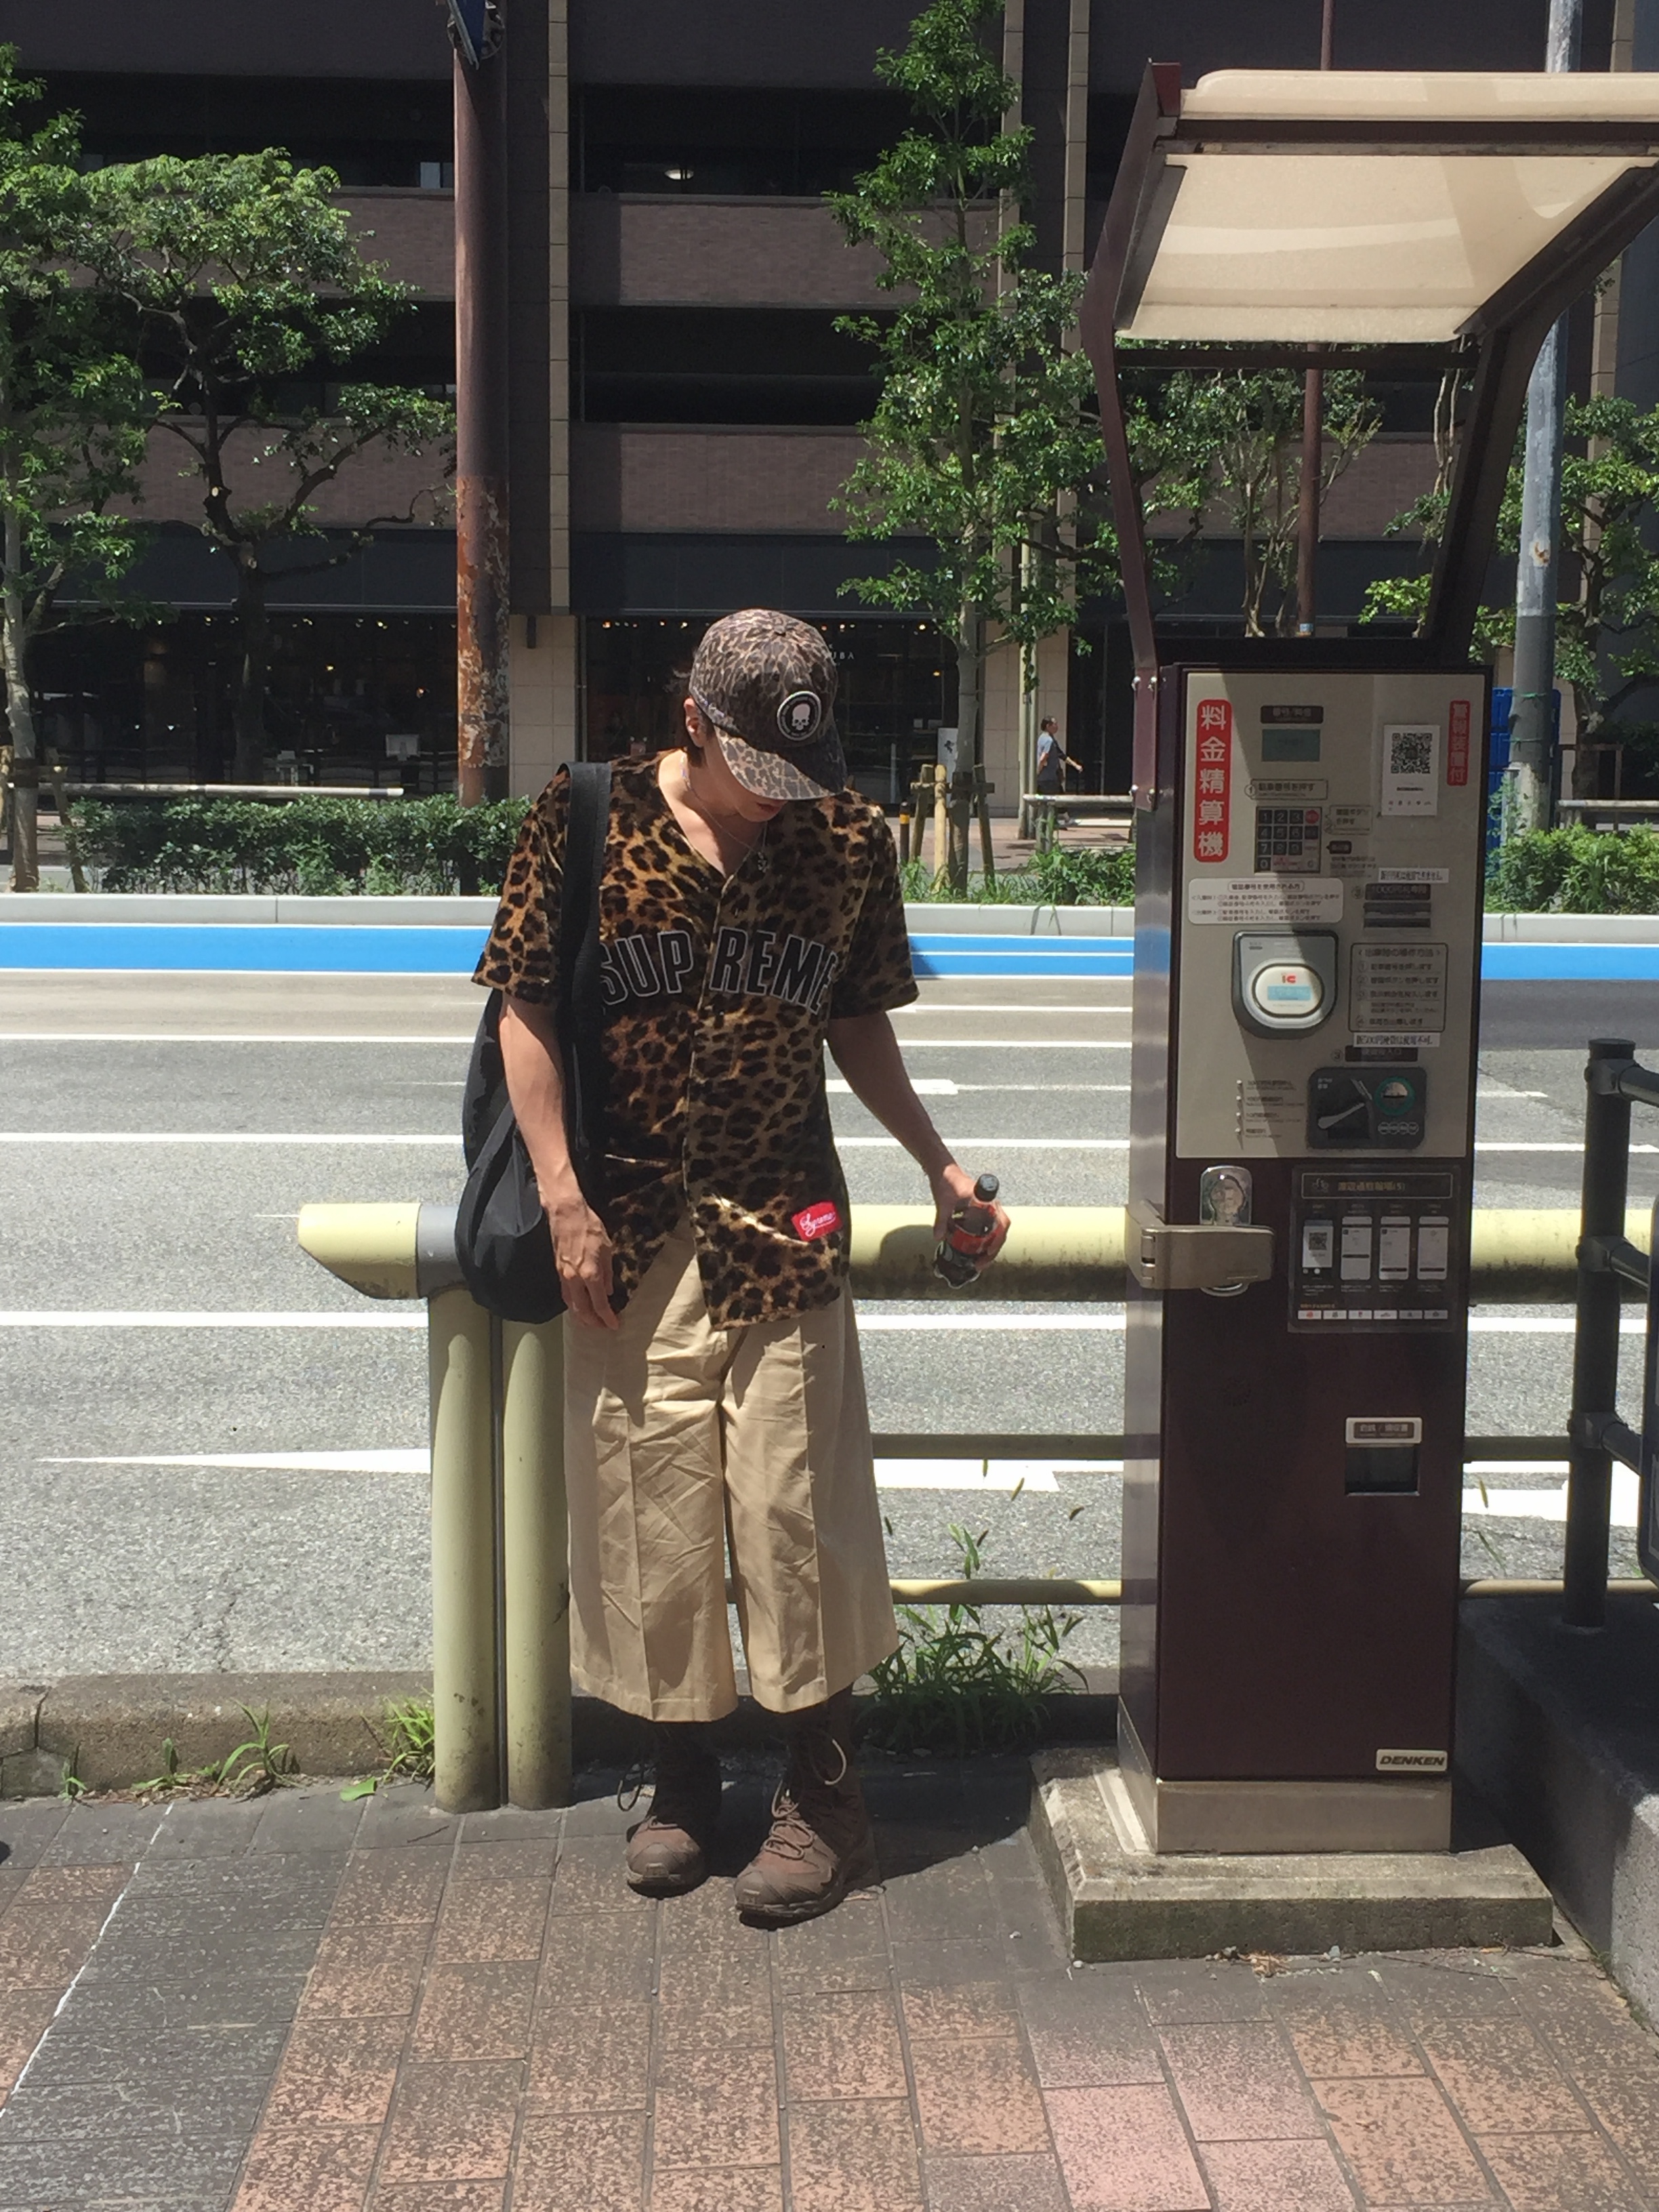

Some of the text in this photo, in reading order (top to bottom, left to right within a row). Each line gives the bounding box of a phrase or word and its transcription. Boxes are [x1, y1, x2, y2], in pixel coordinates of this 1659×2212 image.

[1198, 704, 1227, 857] 料金精算機
[1277, 813, 1285, 822] 2
[1293, 813, 1300, 822] 3
[1276, 828, 1284, 838] 5
[1292, 828, 1300, 838] 6
[1261, 843, 1267, 853] 7
[1260, 859, 1268, 869] 0
[1379, 1756, 1446, 1765] DENKEN
